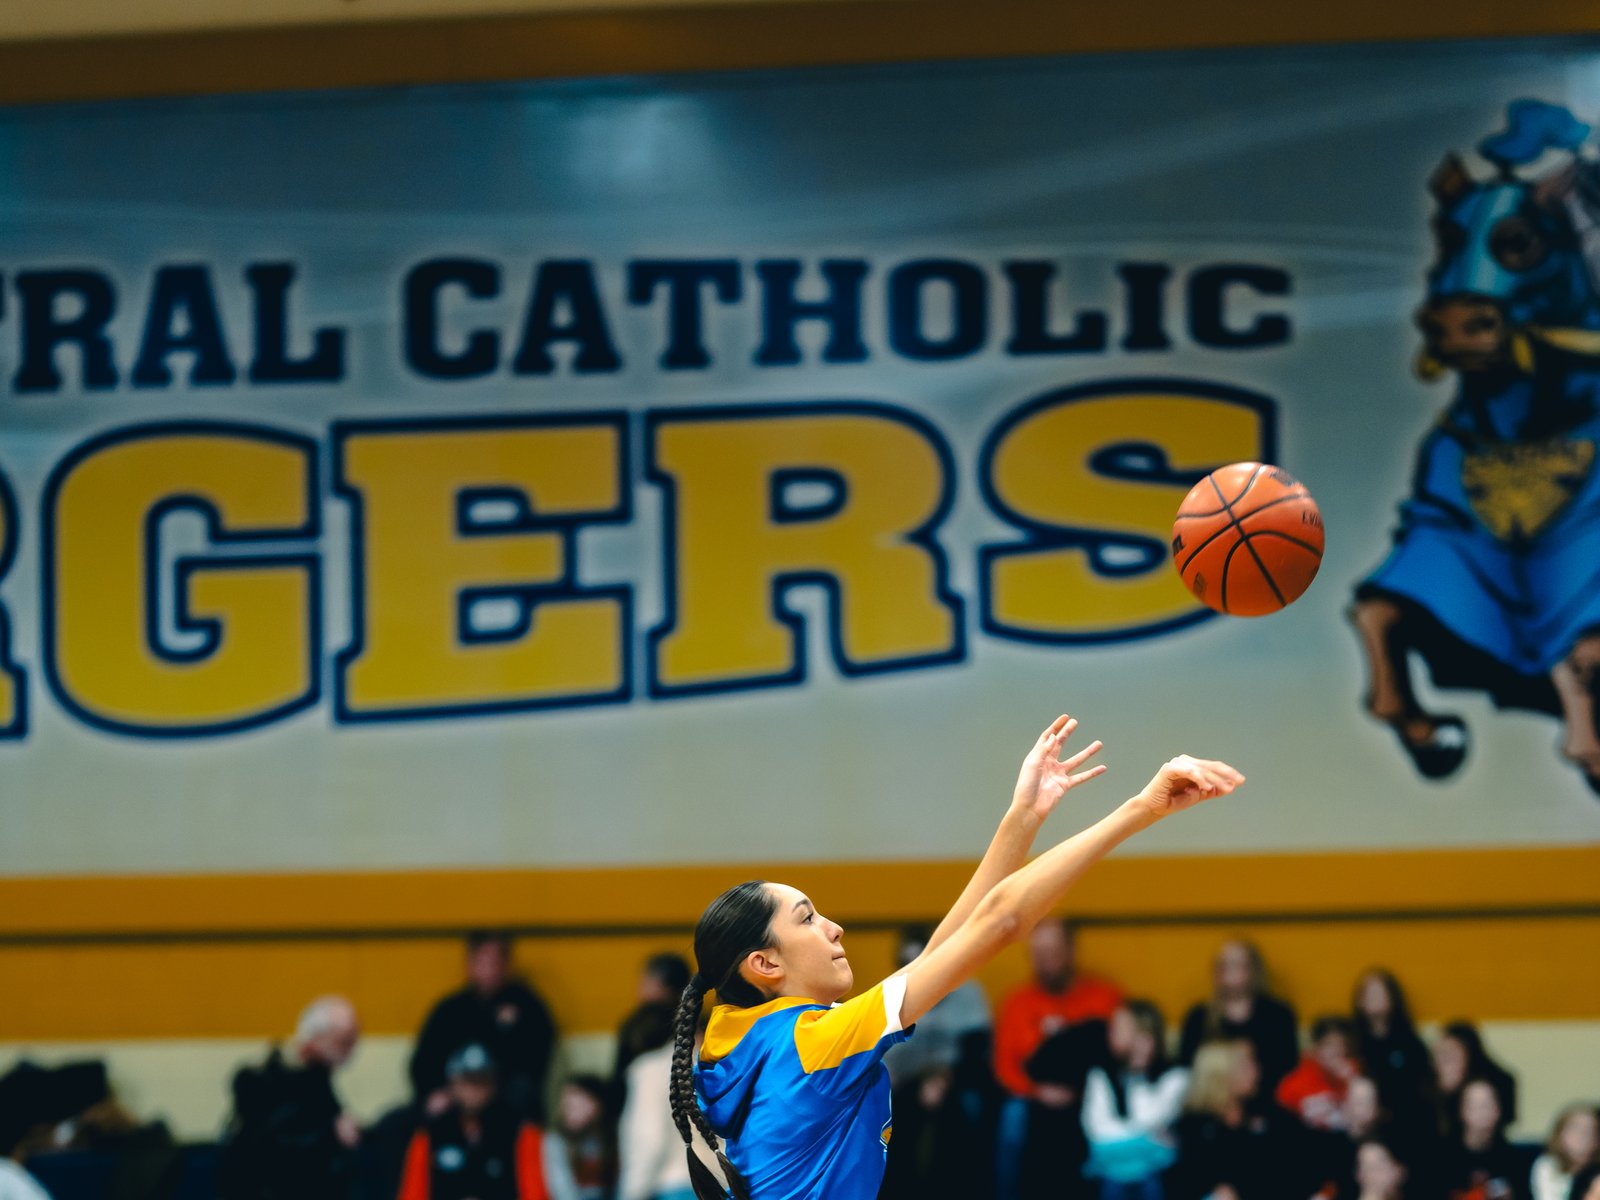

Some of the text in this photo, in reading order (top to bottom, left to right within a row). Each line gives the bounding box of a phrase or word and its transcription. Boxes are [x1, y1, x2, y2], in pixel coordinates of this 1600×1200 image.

[0, 256, 1293, 392] RAL CATHOLIC
[0, 377, 1279, 741] GERS
